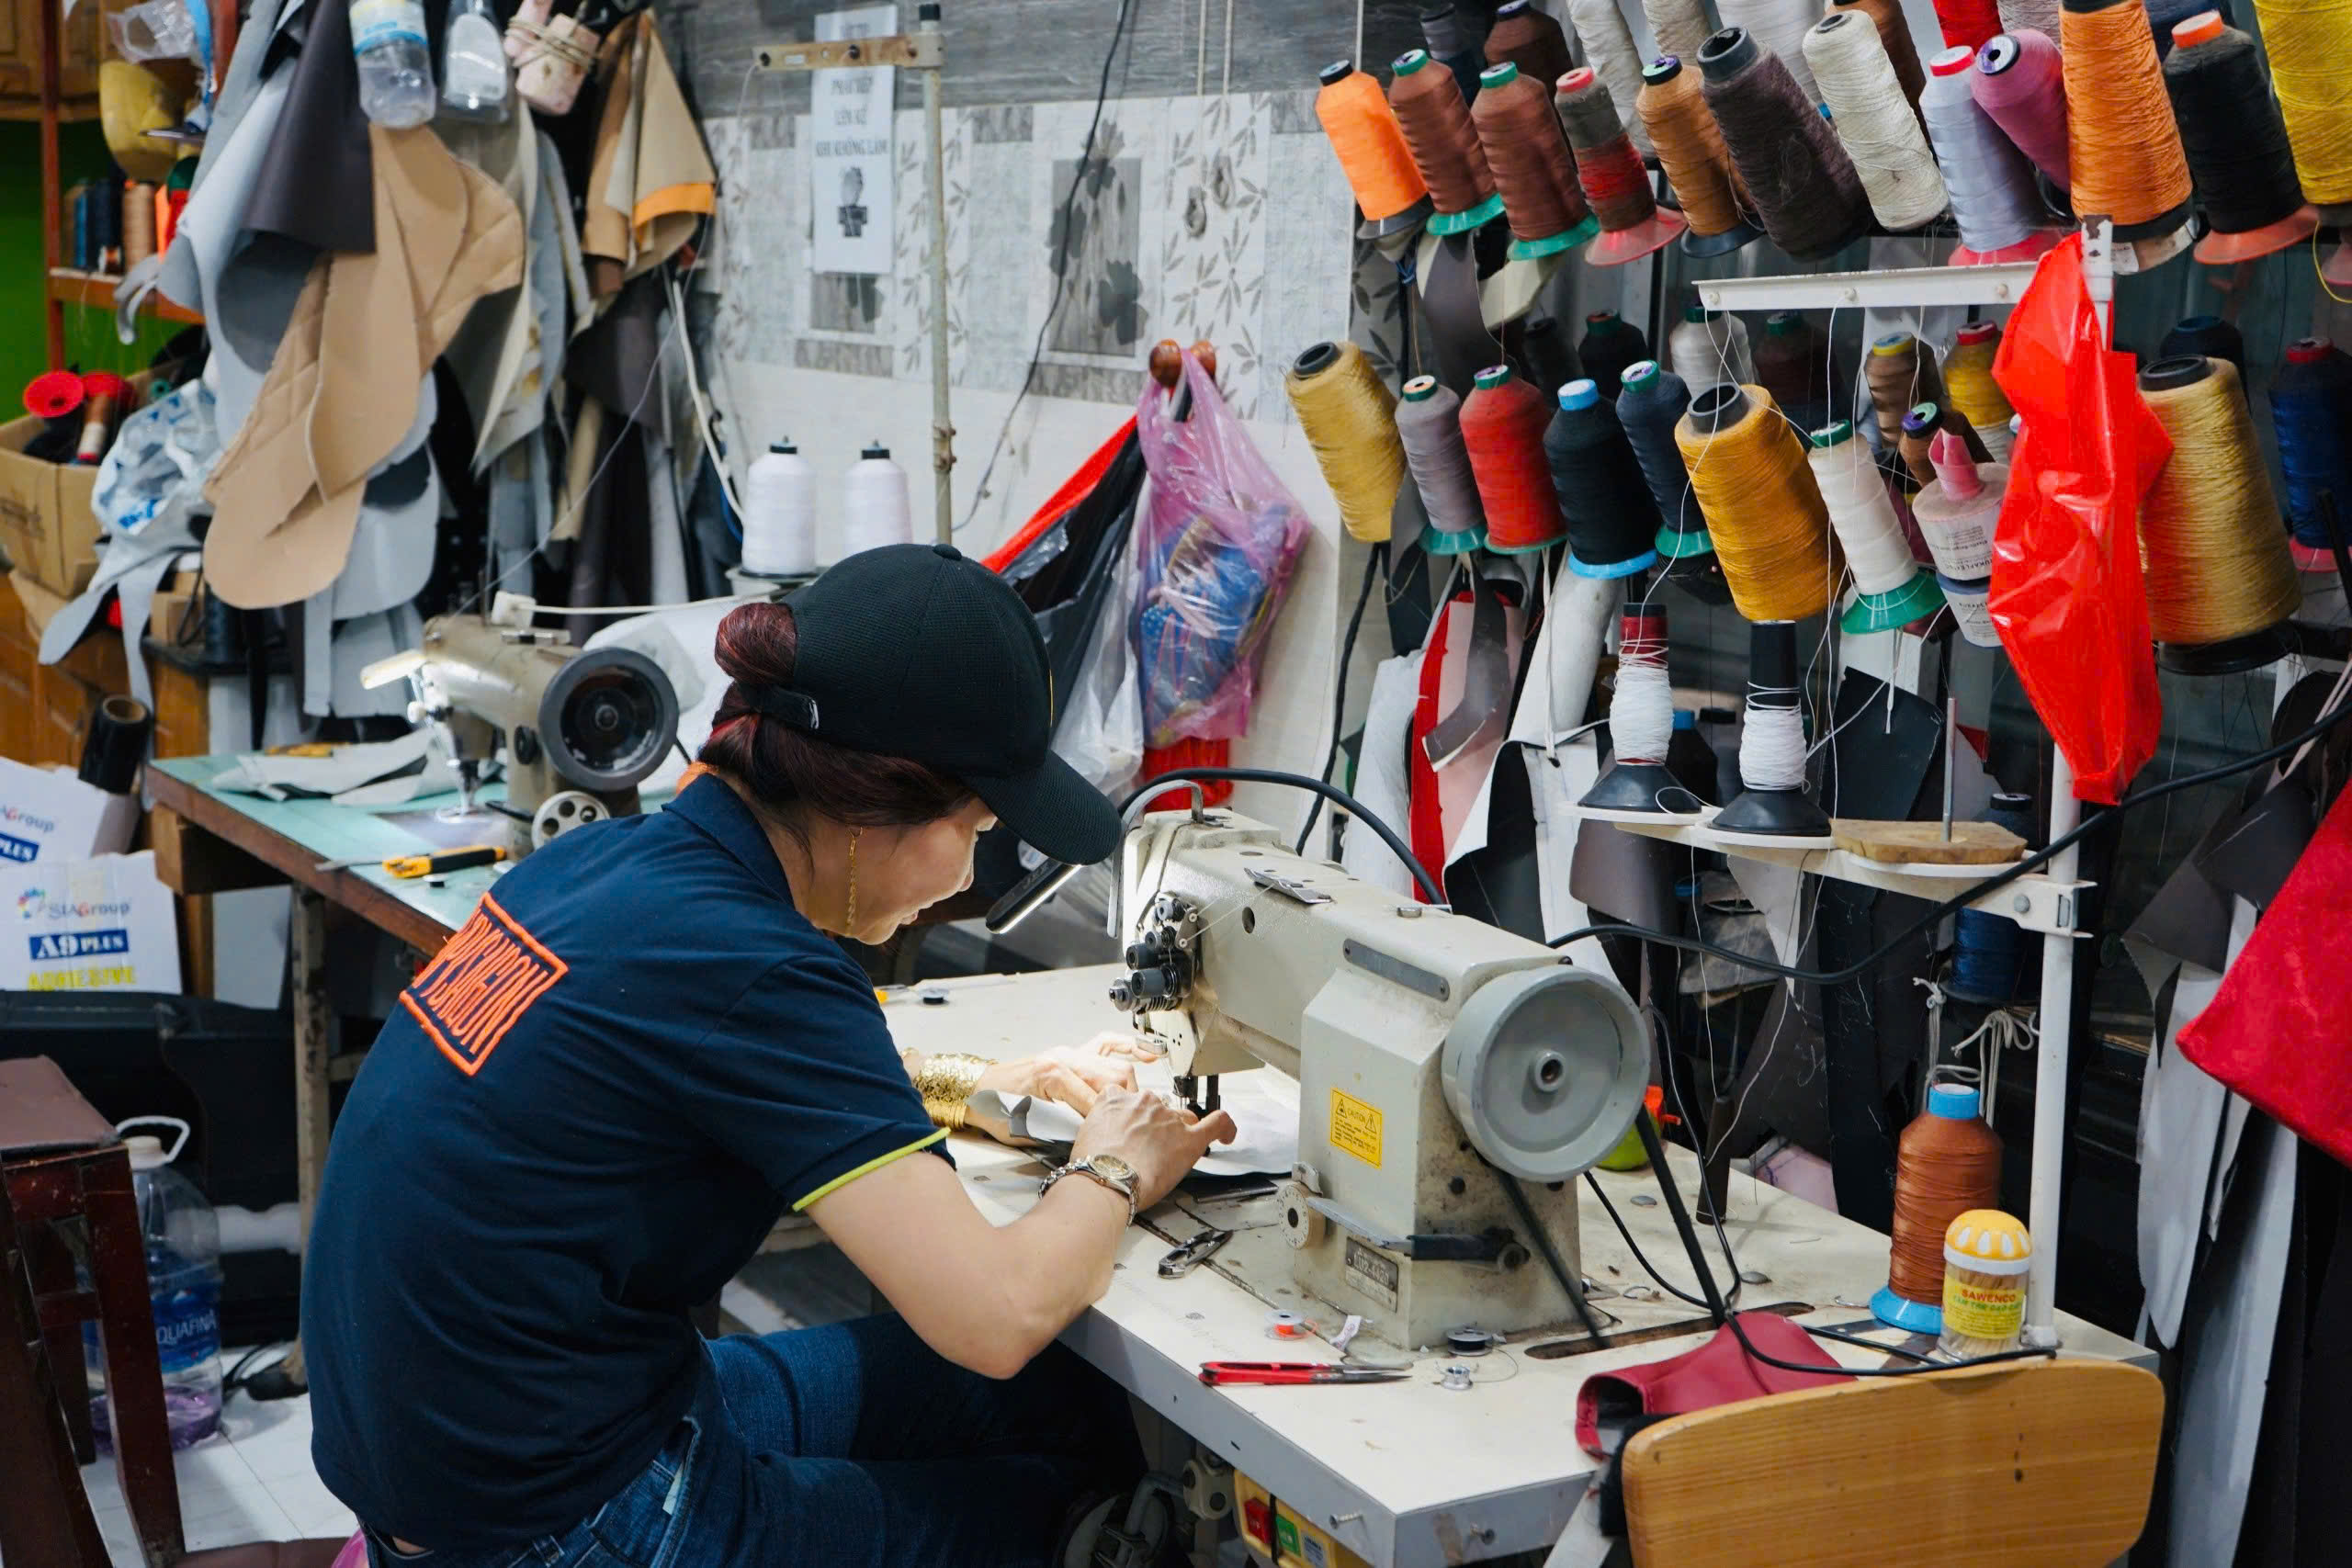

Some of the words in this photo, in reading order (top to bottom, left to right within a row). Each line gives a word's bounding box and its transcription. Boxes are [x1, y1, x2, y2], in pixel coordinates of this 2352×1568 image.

[27, 966, 136, 992] ADHESIVE
[1347, 1108, 1366, 1123] CAUTION
[1962, 1289, 2016, 1303] SAWENCO
[154, 1309, 217, 1346] QUAFINA
